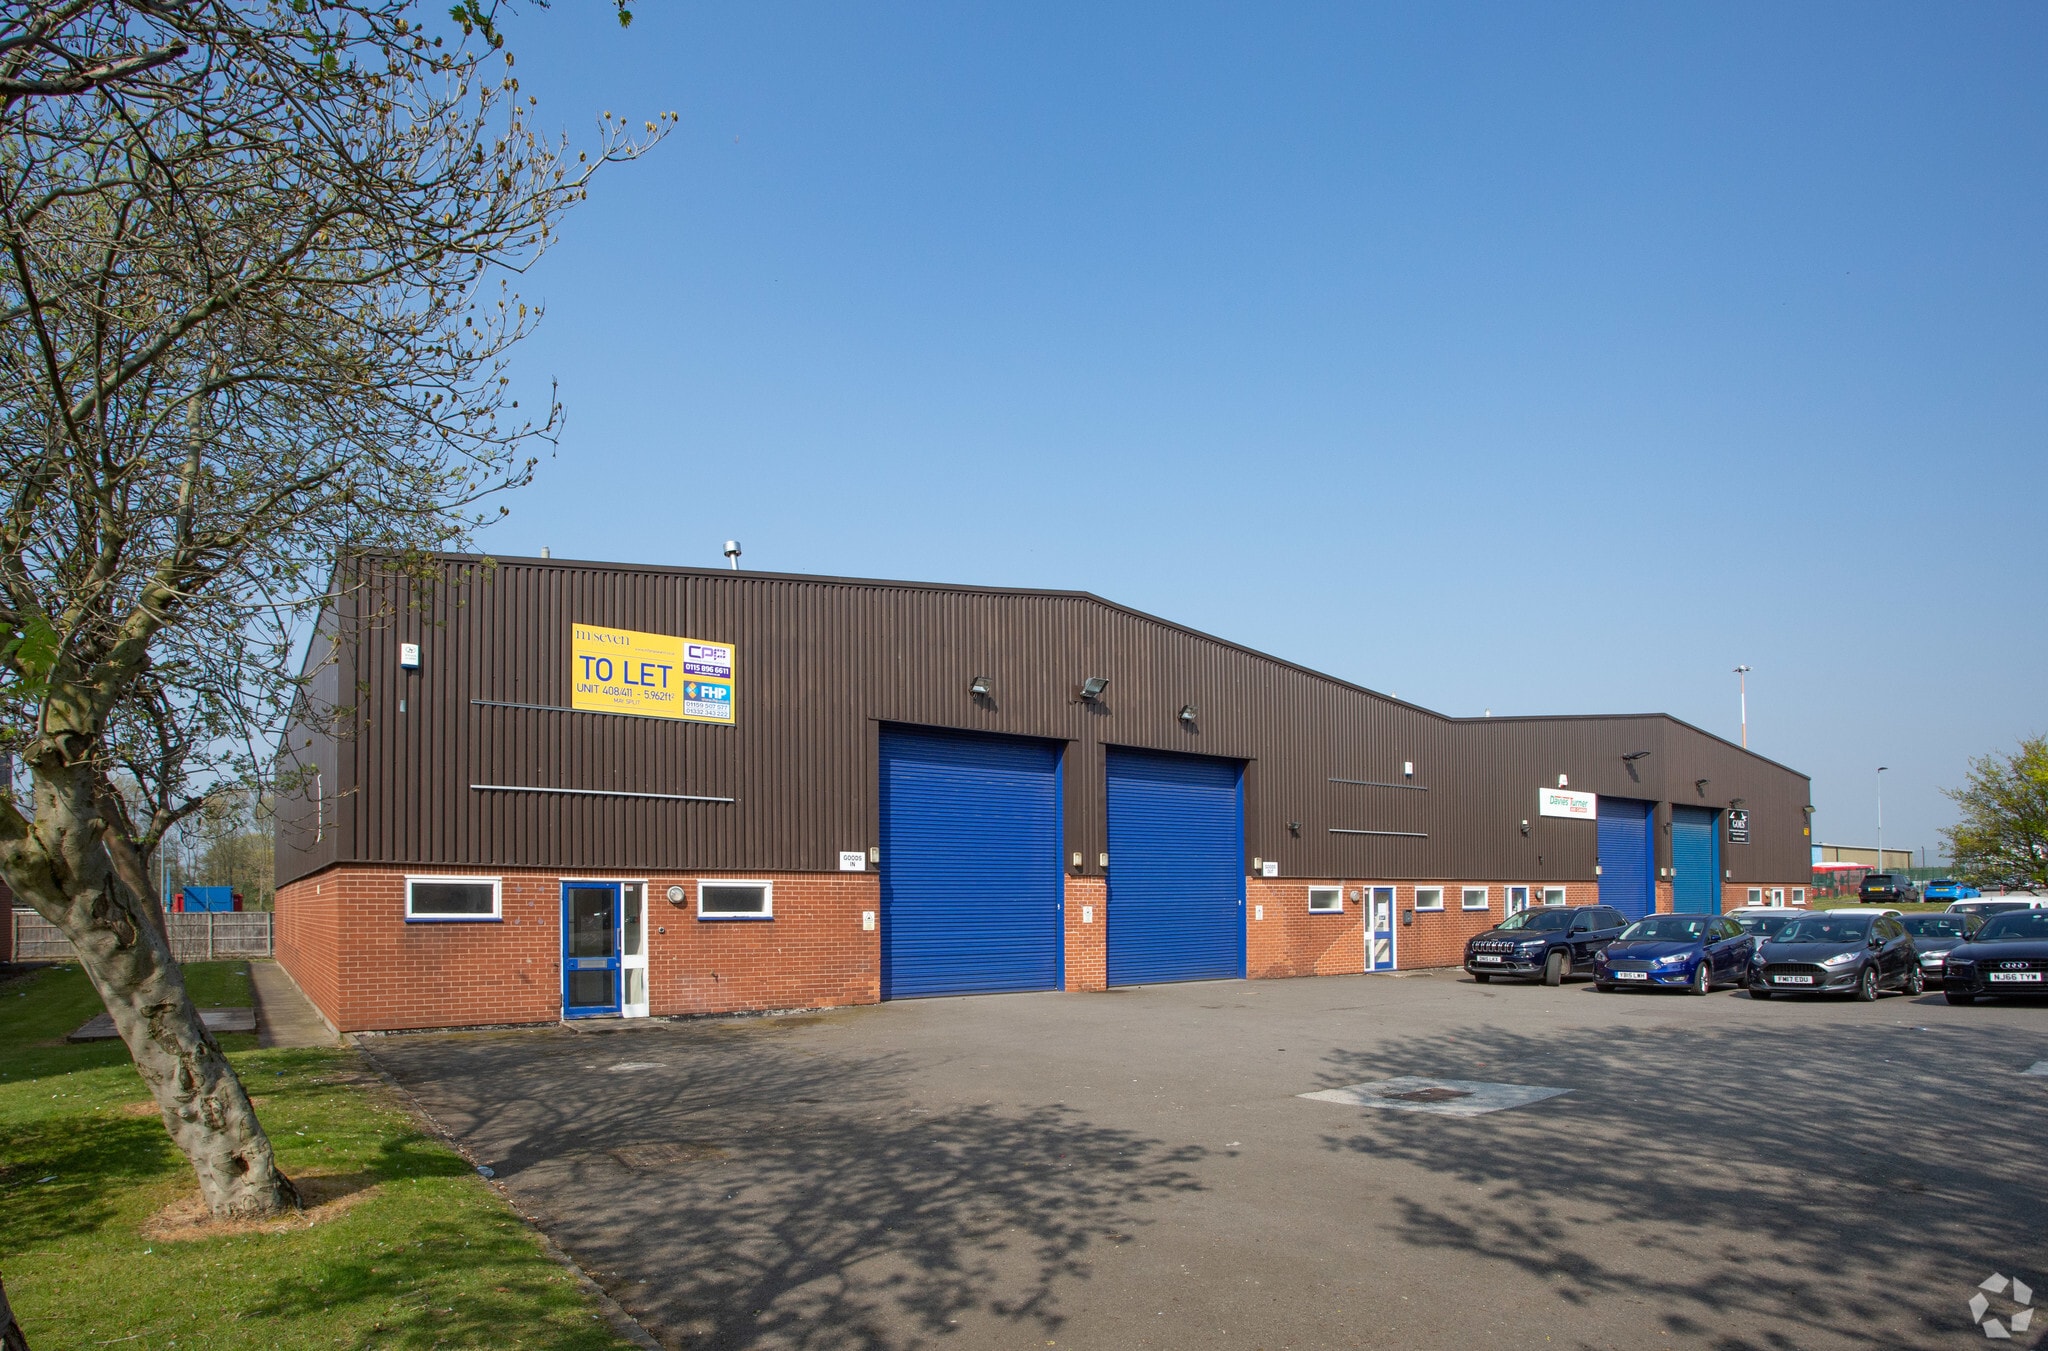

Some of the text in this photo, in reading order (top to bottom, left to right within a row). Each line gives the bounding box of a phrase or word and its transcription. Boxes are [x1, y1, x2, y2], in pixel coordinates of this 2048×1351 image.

[579, 655, 673, 688] TO LET
[685, 663, 700, 671] 0115
[701, 665, 714, 673] 896
[714, 666, 729, 675] 6611
[576, 682, 600, 694] UNIT
[602, 686, 633, 698] 408/411
[701, 685, 727, 699] FHP
[1550, 795, 1588, 808] Davies Turner
[843, 854, 863, 862] GOODS
[1993, 973, 2017, 981] NJ66
